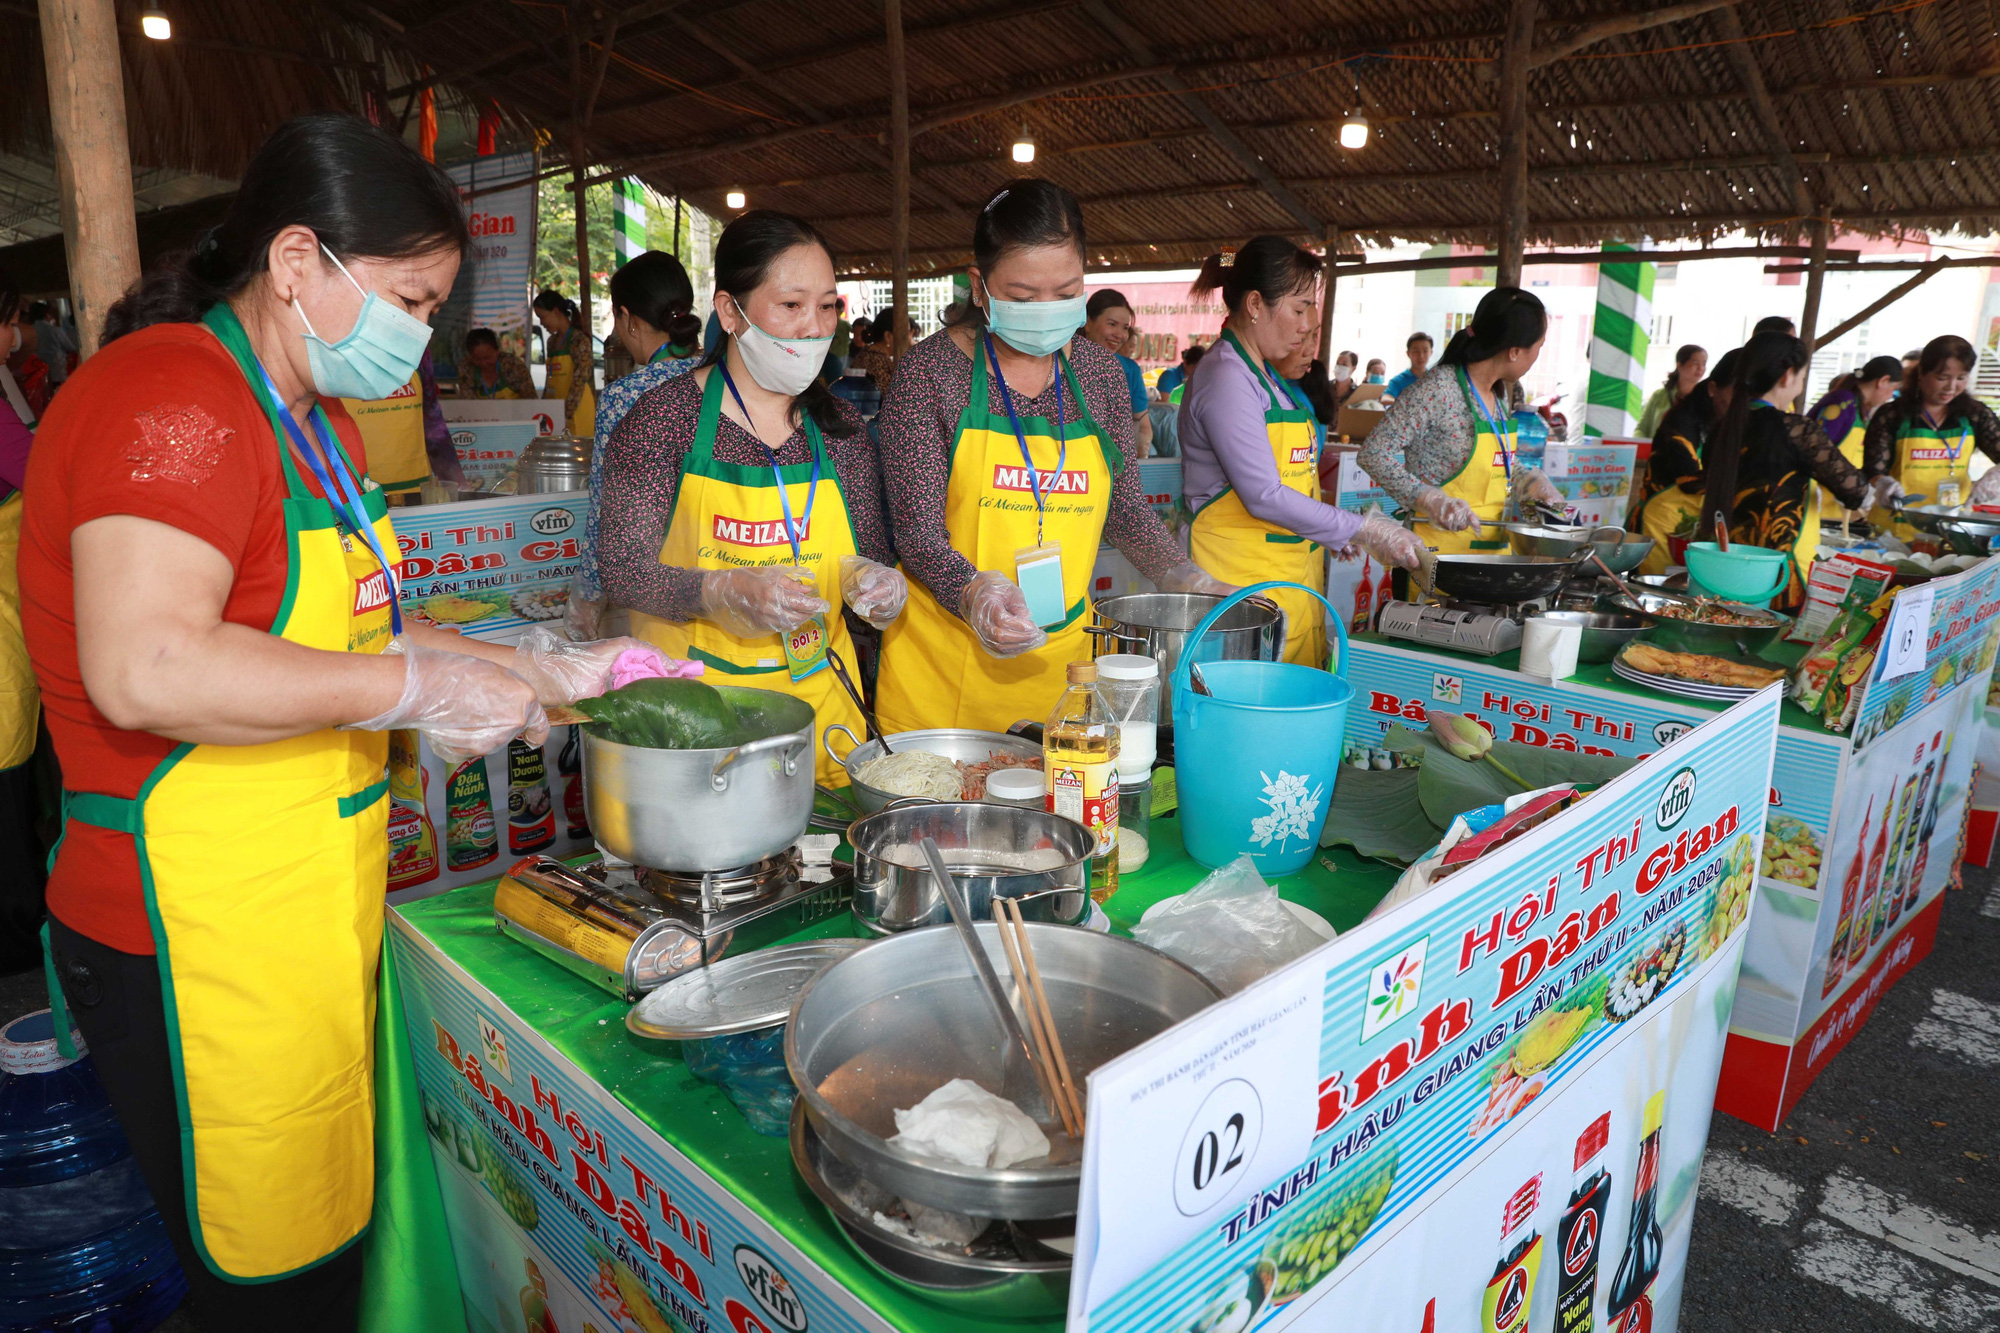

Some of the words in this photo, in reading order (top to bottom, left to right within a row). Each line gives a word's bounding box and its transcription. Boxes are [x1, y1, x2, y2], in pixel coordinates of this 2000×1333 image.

[468, 212, 516, 237] Gian
[772, 341, 801, 358] PROWIN
[979, 496, 994, 507] Có
[995, 499, 1033, 512] Meizan
[1073, 505, 1095, 516] ngay
[536, 513, 568, 530] vfm
[398, 531, 432, 553] ội
[446, 521, 515, 546] Thi
[402, 552, 508, 580] Dân
[698, 546, 714, 558] Có
[715, 550, 755, 567] Meizan
[416, 580, 459, 599] LẦN
[464, 573, 506, 591] THỨ
[510, 573, 521, 584] II
[537, 563, 581, 580] NĂM
[792, 634, 811, 651] ĐỘI
[812, 629, 819, 642] 2
[1900, 630, 1913, 653] 03
[1482, 691, 1552, 722] Hội
[1564, 709, 1637, 742] Thi
[513, 764, 544, 777] Dương
[516, 754, 538, 765] Nam
[454, 782, 485, 798] Nành
[456, 771, 481, 787] Đậu
[1056, 778, 1082, 788] MEIZAN
[1660, 783, 1692, 823] vfm
[1456, 872, 1561, 978] Hội
[1575, 814, 1645, 894] Thi
[1316, 997, 1473, 1140] ánh
[1491, 890, 1622, 1013] Dân
[1635, 804, 1740, 898] Gian
[21, 1049, 45, 1060] Lotus
[1221, 1160, 1318, 1248] TỈNH
[1328, 1094, 1407, 1173] HẬU
[1412, 1020, 1508, 1107] GIANG
[1513, 976, 1565, 1034] LẦN
[1569, 934, 1615, 987] THỨ
[1614, 926, 1629, 951] II
[1641, 888, 1685, 932] NĂM
[1685, 856, 1724, 898] 2020
[432, 1018, 563, 1171] Bánh
[570, 1148, 709, 1311] Dân
[1193, 1112, 1246, 1191] 02
[531, 1072, 611, 1173] Hội
[621, 1153, 715, 1267] Thi
[450, 1075, 488, 1127] TỈNH
[491, 1116, 530, 1168] HẬU
[532, 1161, 599, 1238] GIANG
[602, 1225, 652, 1285] LẦN
[654, 1275, 710, 1333] THỨ
[742, 1261, 799, 1328] vfm
[1560, 1295, 1576, 1311] NƯỚC
[1576, 1274, 1594, 1296] TƯƠNG
[1562, 1296, 1589, 1329] Nam
